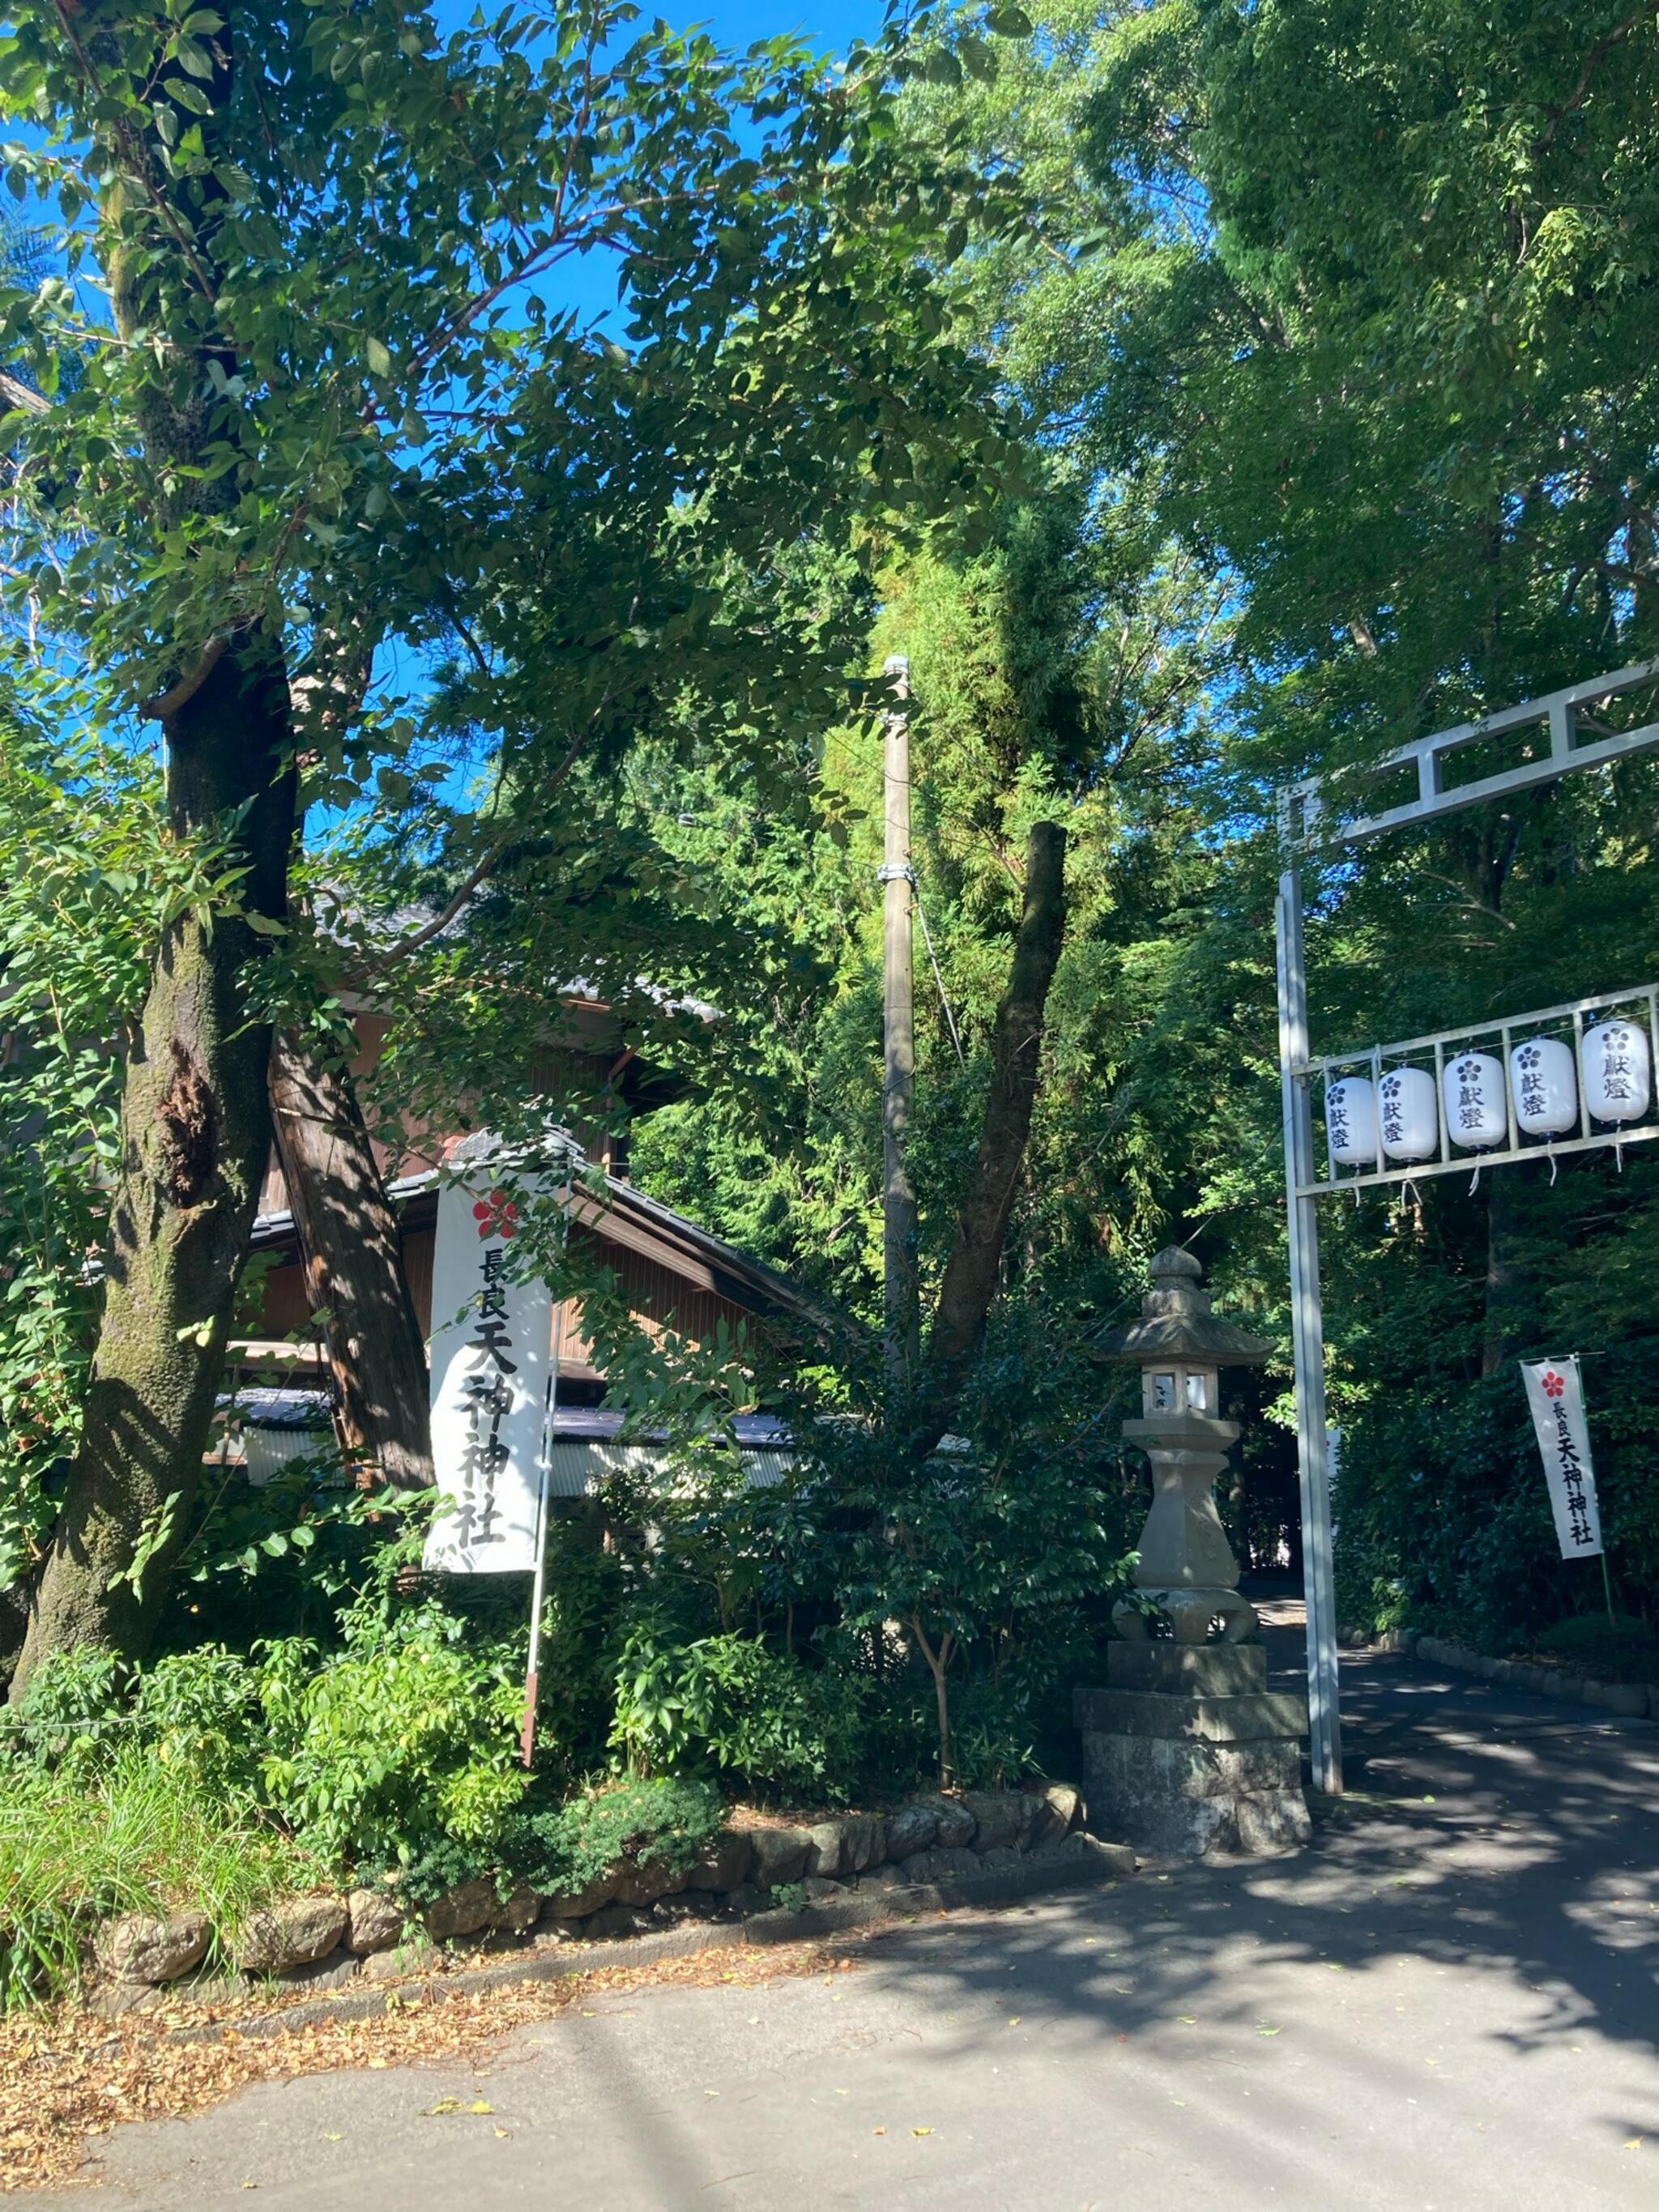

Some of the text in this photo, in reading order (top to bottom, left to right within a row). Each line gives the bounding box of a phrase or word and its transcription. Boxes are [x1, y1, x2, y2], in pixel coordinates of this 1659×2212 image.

[451, 1248, 518, 1549] 長良天神神社
[1552, 1401, 1593, 1545] 長良天神神社
